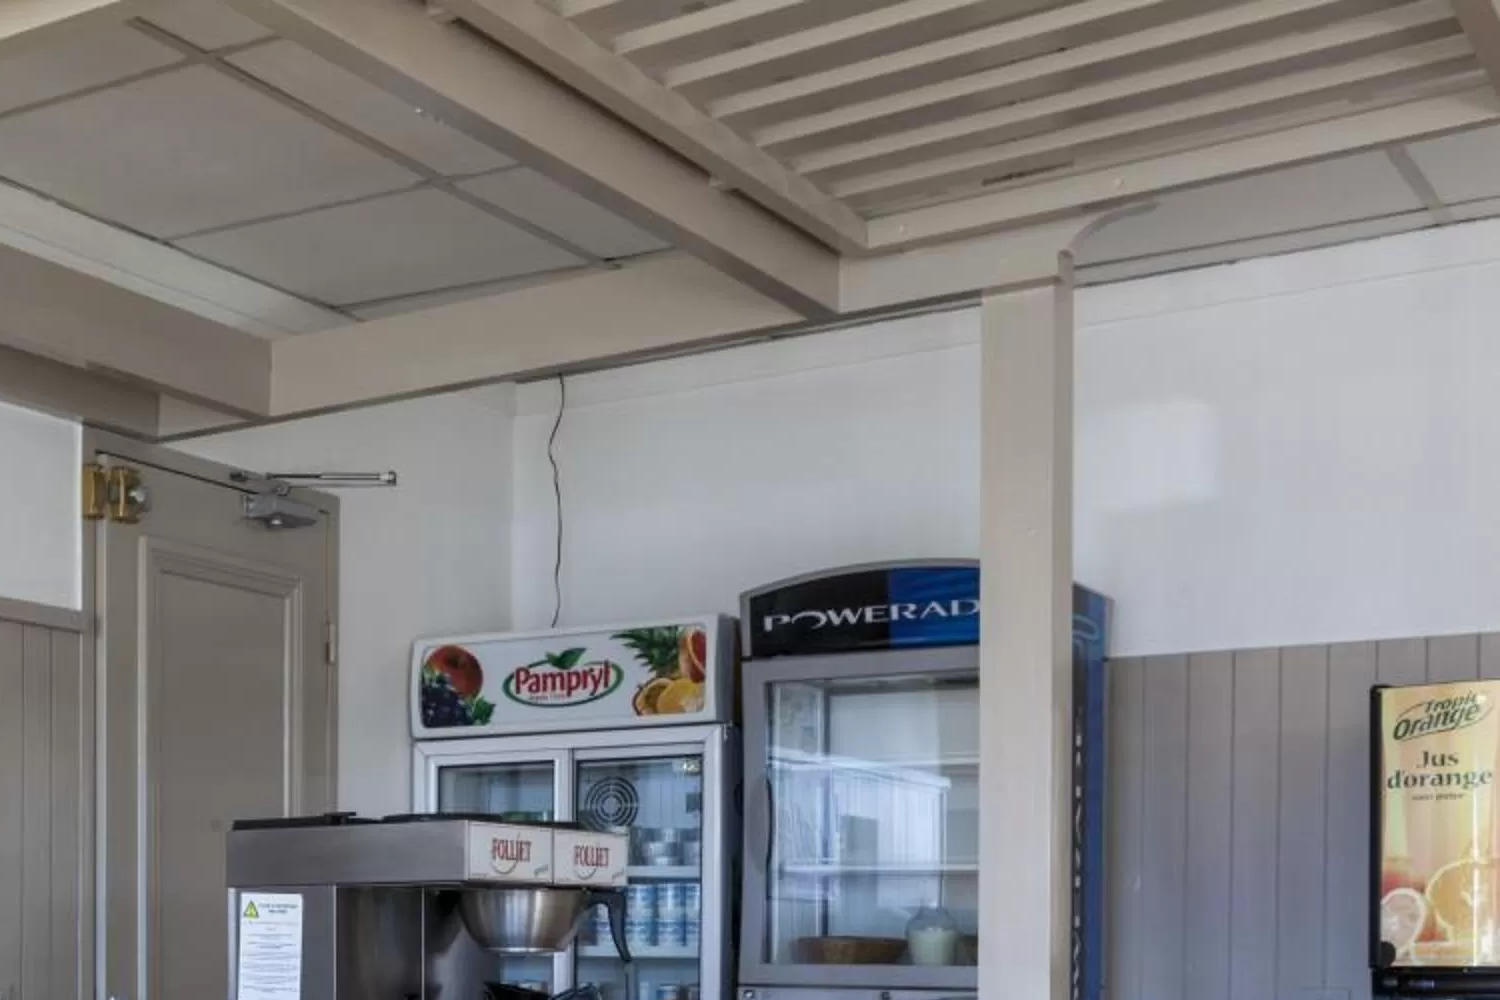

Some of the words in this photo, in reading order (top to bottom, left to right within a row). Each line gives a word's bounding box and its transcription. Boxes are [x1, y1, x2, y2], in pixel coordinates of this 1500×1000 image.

[763, 599, 980, 632] POWERAD
[515, 659, 611, 697] Pampryl
[1393, 704, 1481, 740] Orange
[1416, 750, 1459, 768] Jus
[1387, 769, 1493, 790] d'orange
